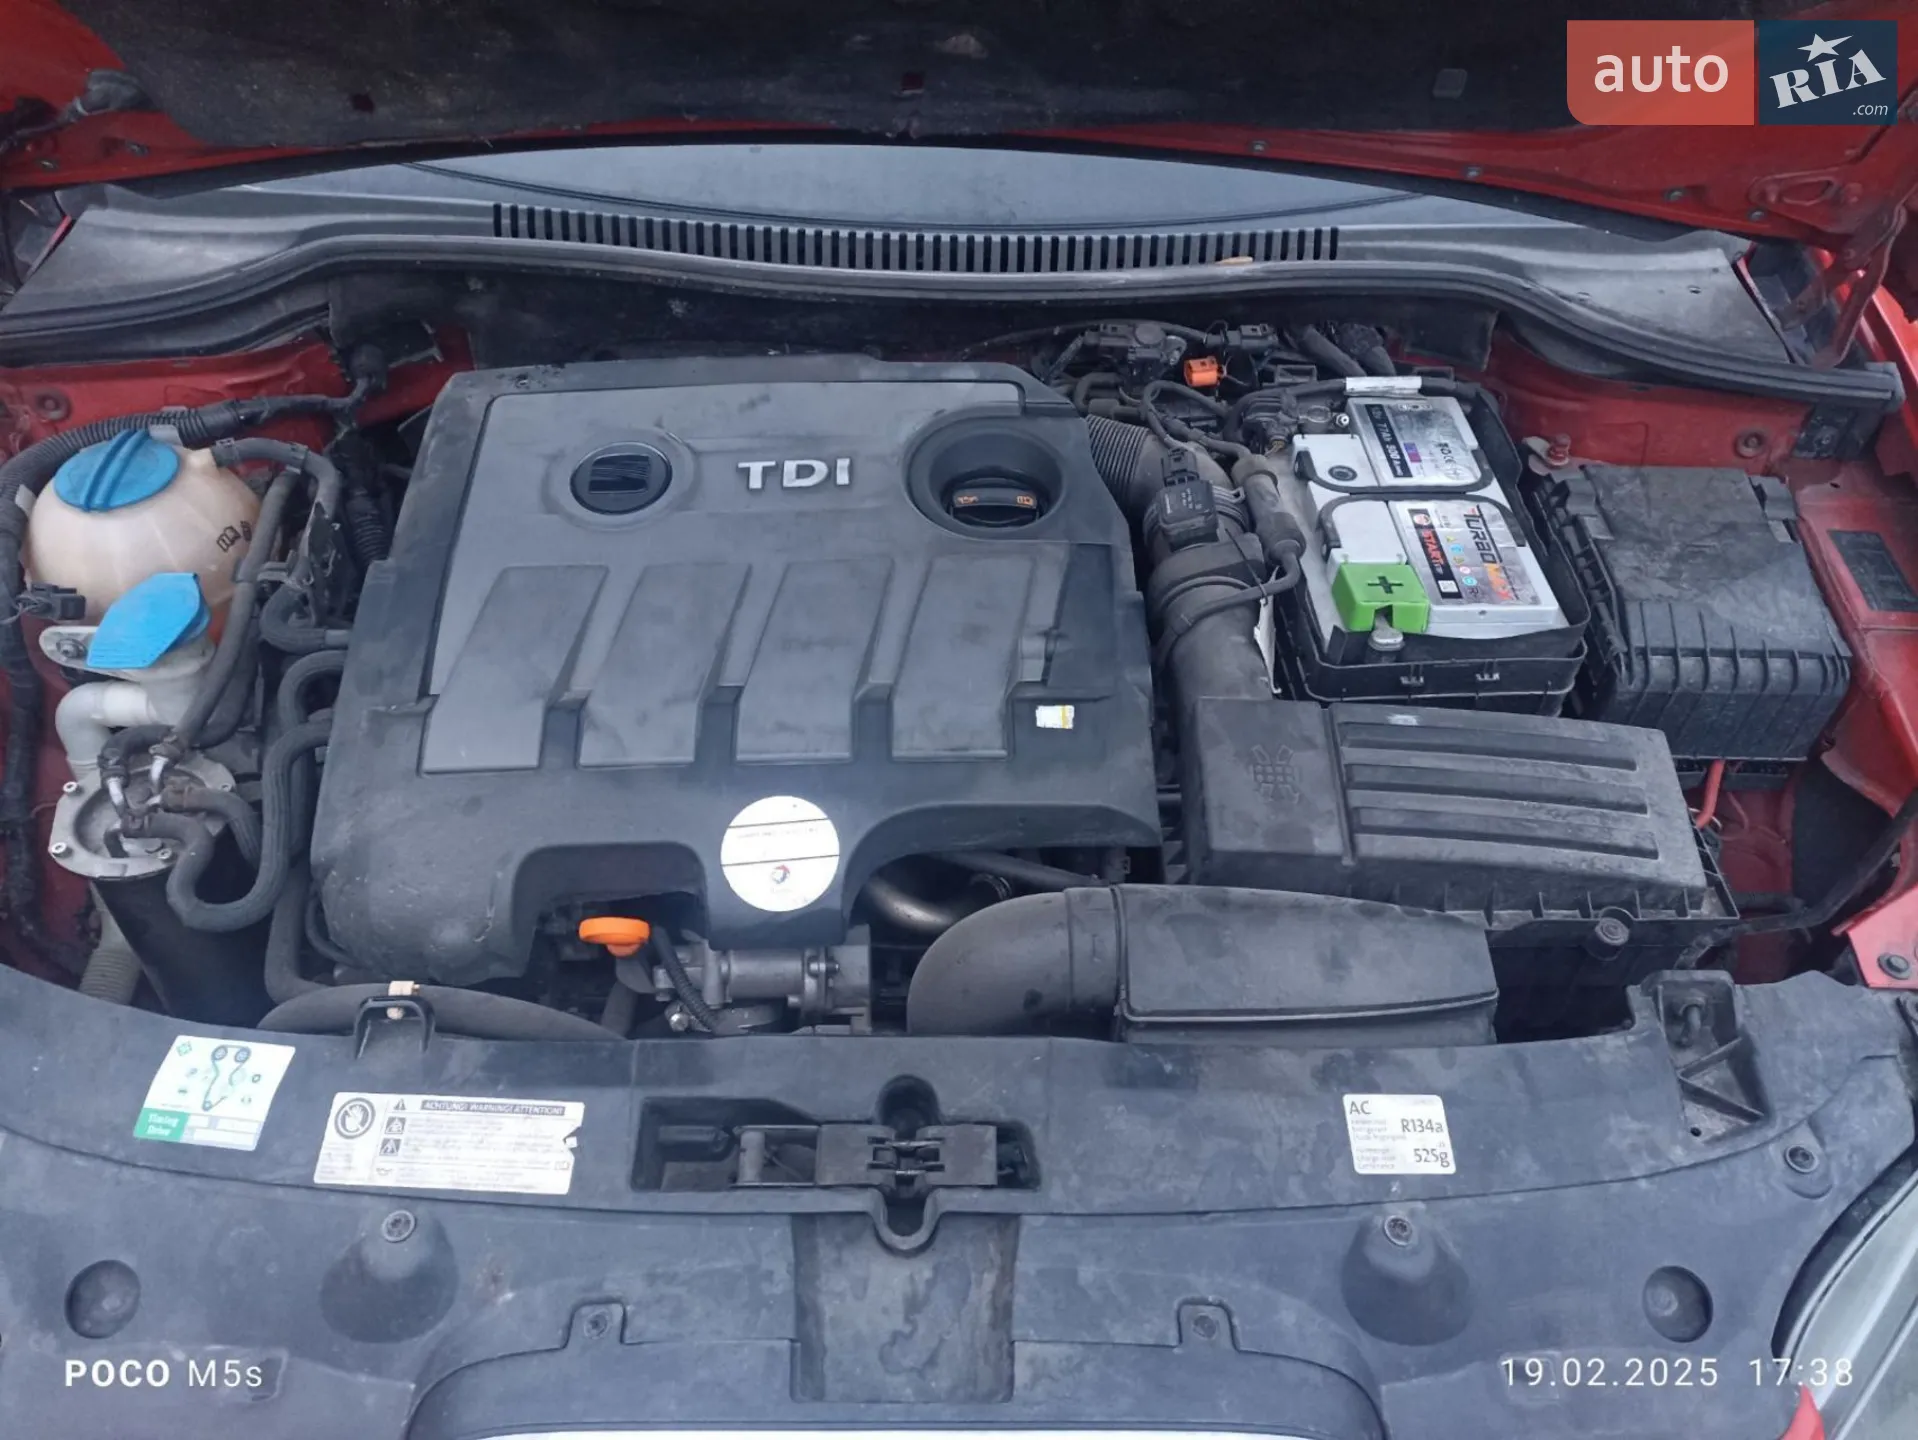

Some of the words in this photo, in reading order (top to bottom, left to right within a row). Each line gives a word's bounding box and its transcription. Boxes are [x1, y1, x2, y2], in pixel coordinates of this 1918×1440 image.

[737, 457, 850, 489] TDI
[1349, 1100, 1372, 1115] AC
[1400, 1118, 1445, 1134] R134a
[1413, 1148, 1451, 1169] 525g
